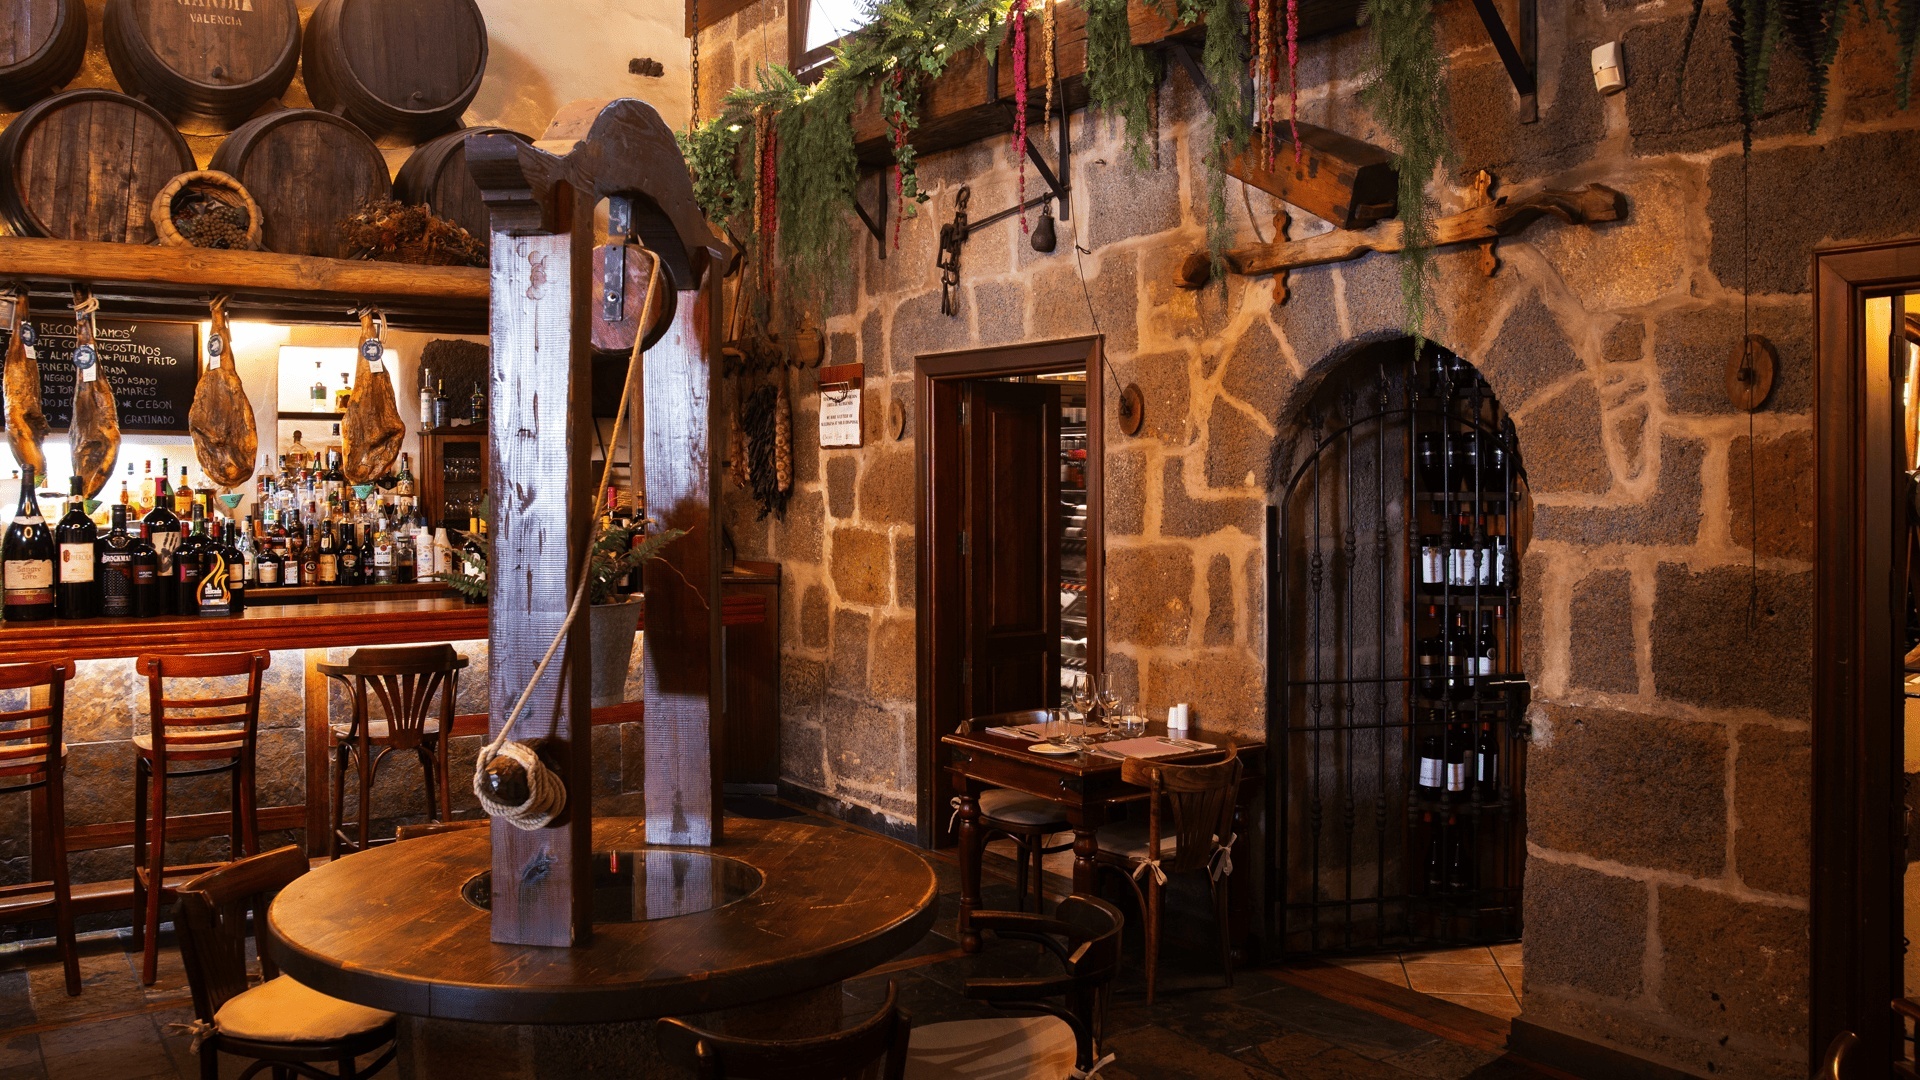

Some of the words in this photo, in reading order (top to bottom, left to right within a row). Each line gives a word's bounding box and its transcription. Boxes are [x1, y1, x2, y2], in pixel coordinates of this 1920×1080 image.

[189, 13, 242, 26] VALENCIA
[113, 353, 140, 364] PULPO
[147, 356, 177, 366] FRITO
[37, 362, 76, 372] ERNERA
[104, 365, 127, 375] RADA
[44, 374, 73, 382] NEGRO
[107, 376, 124, 385] ESO
[127, 376, 158, 386] ASADO
[44, 385, 55, 394] DE
[59, 385, 74, 394] TOR
[135, 400, 172, 409] CEBON
[124, 414, 175, 425] GRATINADO
